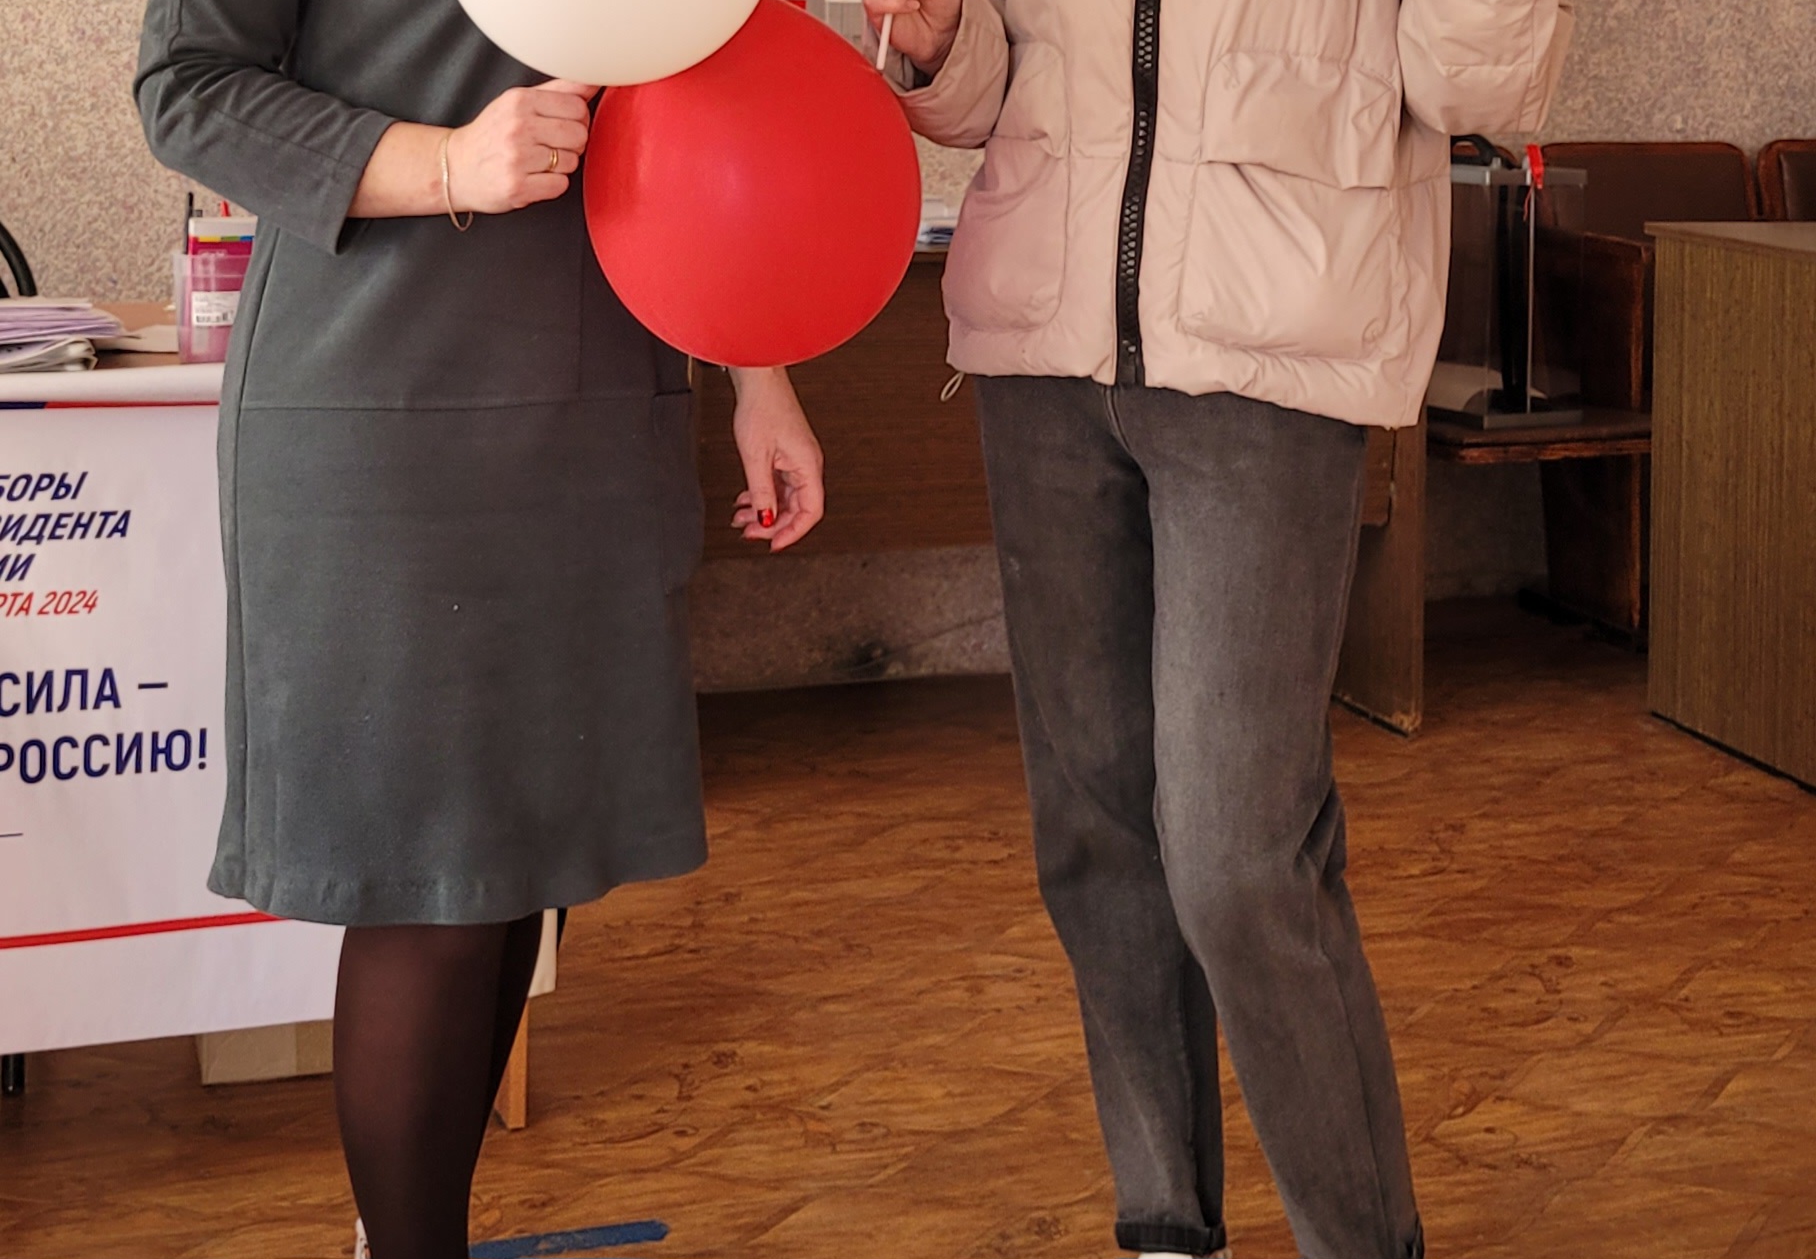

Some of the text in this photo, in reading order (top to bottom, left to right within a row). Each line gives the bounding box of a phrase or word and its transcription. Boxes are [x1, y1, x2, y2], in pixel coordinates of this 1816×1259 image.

[0, 510, 131, 546] ИДЕНТА
[37, 590, 98, 615] 2024
[0, 668, 121, 717] СИЛА
